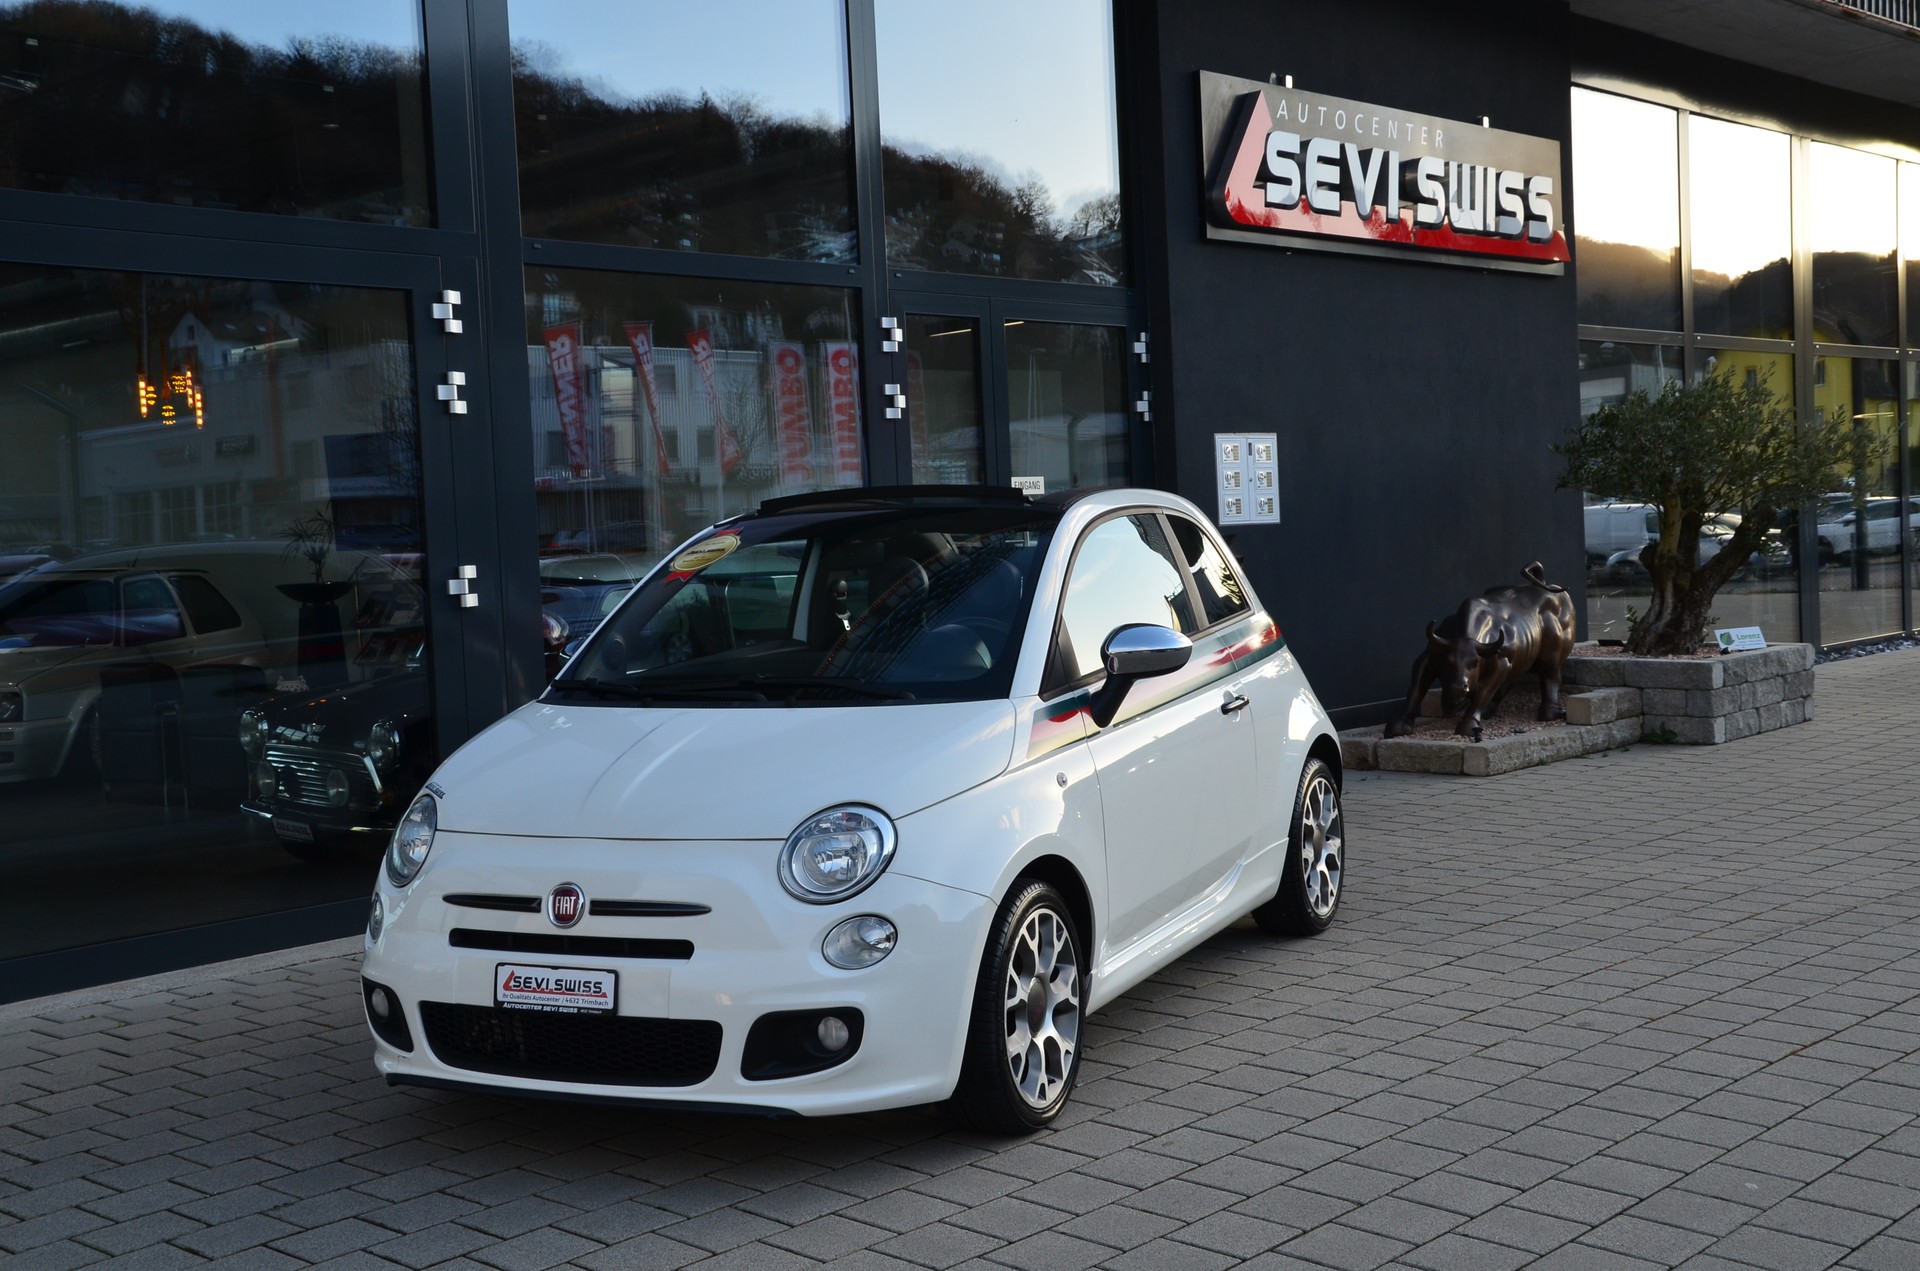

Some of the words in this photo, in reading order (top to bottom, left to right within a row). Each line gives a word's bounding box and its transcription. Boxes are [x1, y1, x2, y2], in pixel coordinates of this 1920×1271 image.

[1276, 98, 1444, 149] AUTOCENTER
[1265, 130, 1400, 222] SEVI
[1417, 155, 1554, 243] SWISS
[777, 347, 815, 481] JUMBO
[1014, 480, 1040, 490] EINGANG
[555, 896, 577, 915] FIAT
[512, 975, 550, 991] SEVI
[554, 978, 603, 994] SWISS
[565, 997, 580, 1005] 4632
[581, 998, 609, 1007] Trimbach
